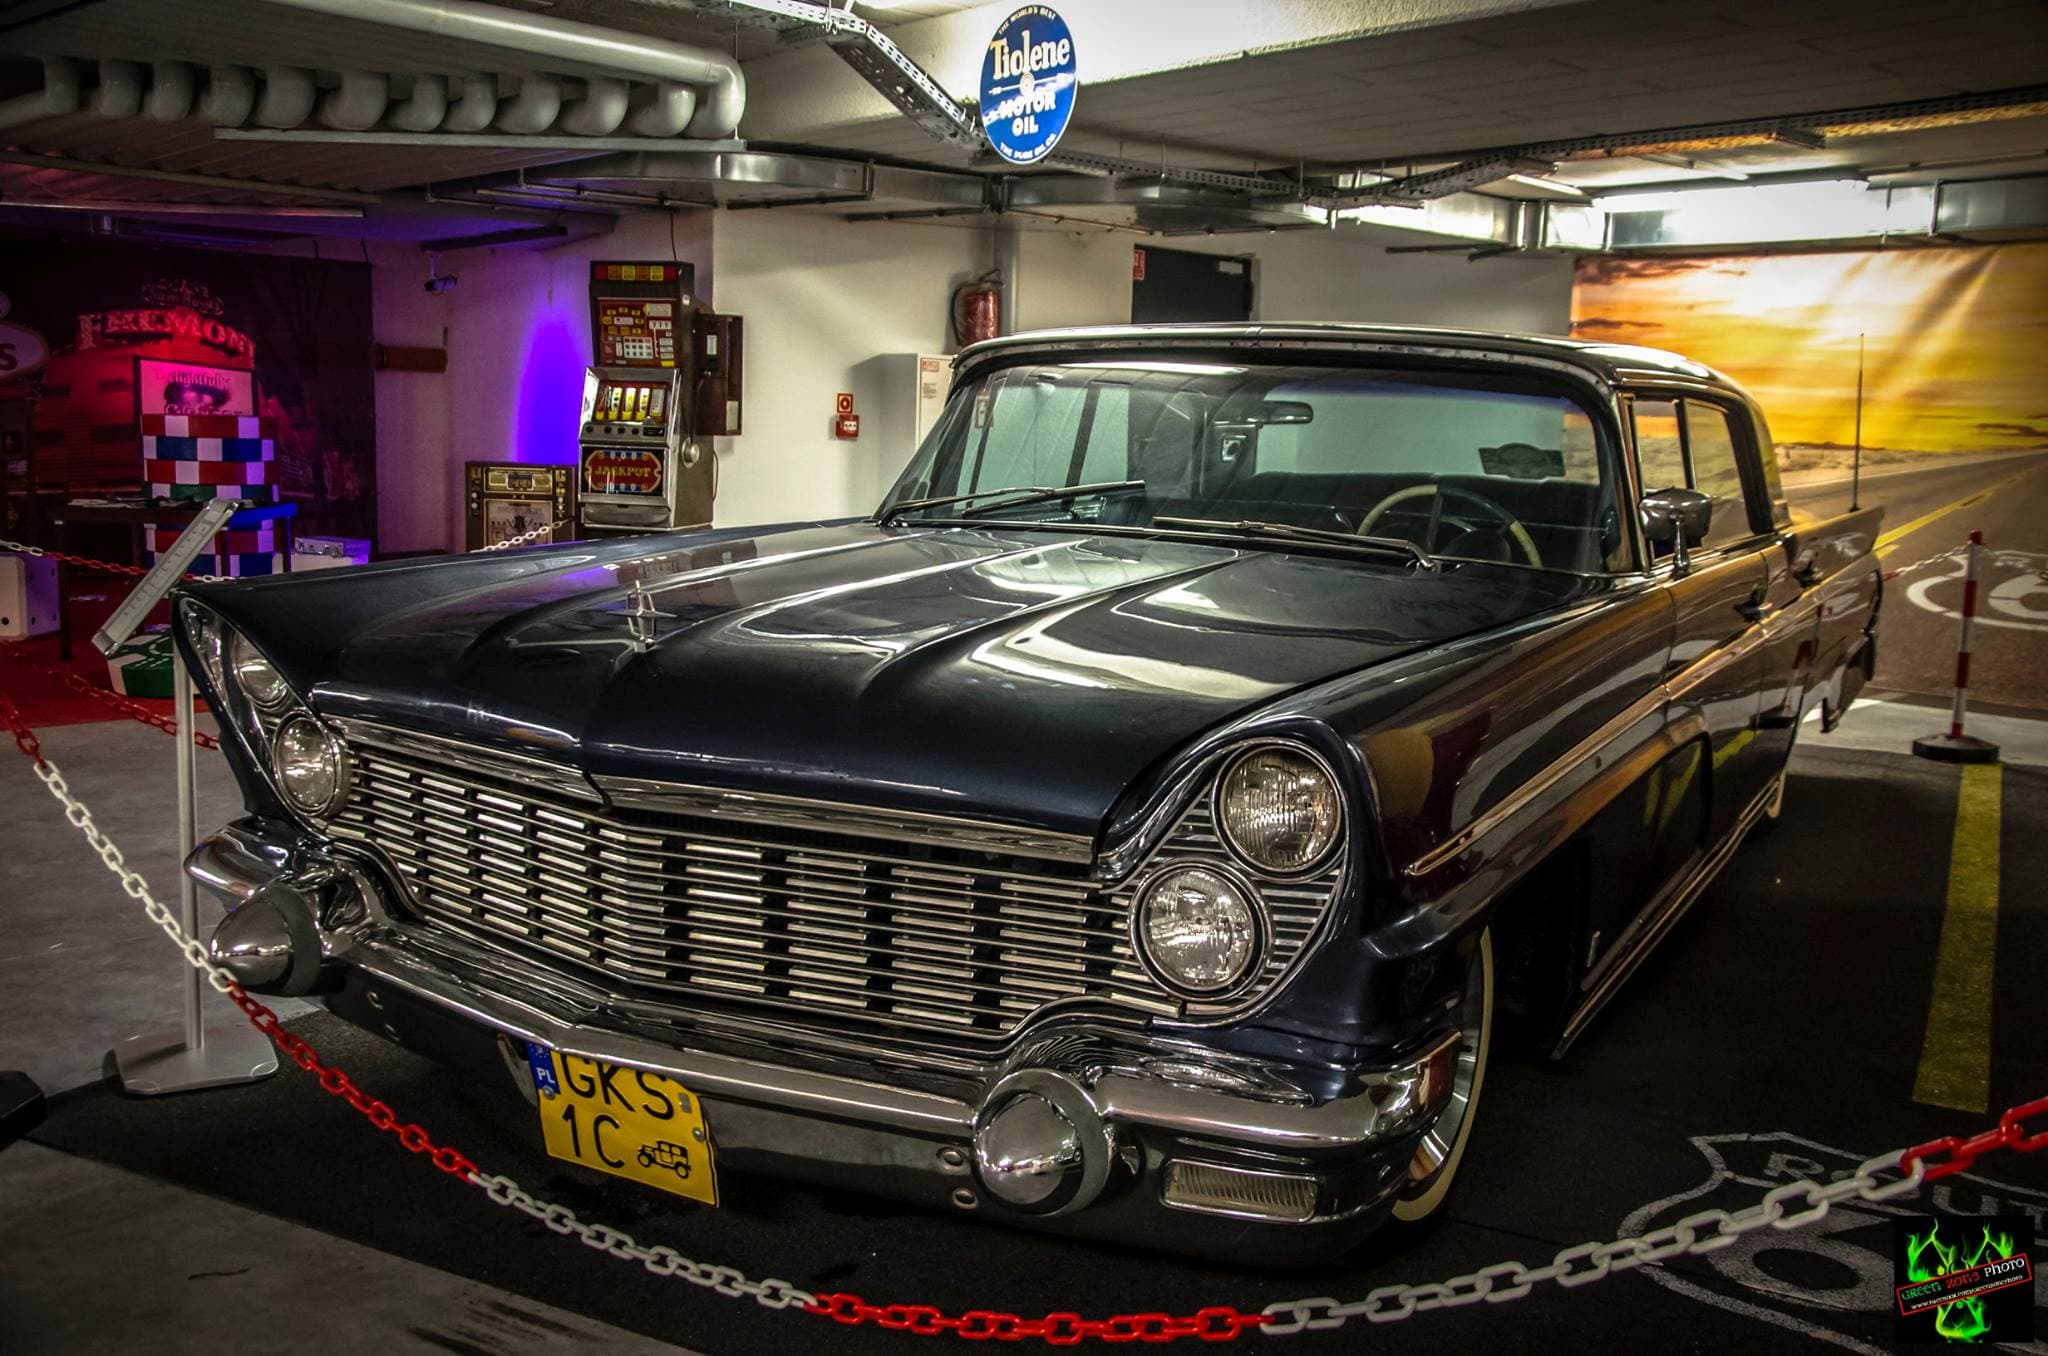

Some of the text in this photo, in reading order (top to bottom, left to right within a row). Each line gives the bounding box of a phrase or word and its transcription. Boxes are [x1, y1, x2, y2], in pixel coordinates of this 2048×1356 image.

[990, 30, 1070, 80] Tiolene
[999, 86, 1056, 120] MOTOR
[1012, 115, 1039, 136] OIL
[594, 465, 652, 478] JACKPOT
[536, 1066, 556, 1084] PL
[560, 1053, 675, 1121] GKS
[562, 1103, 625, 1169] 1C
